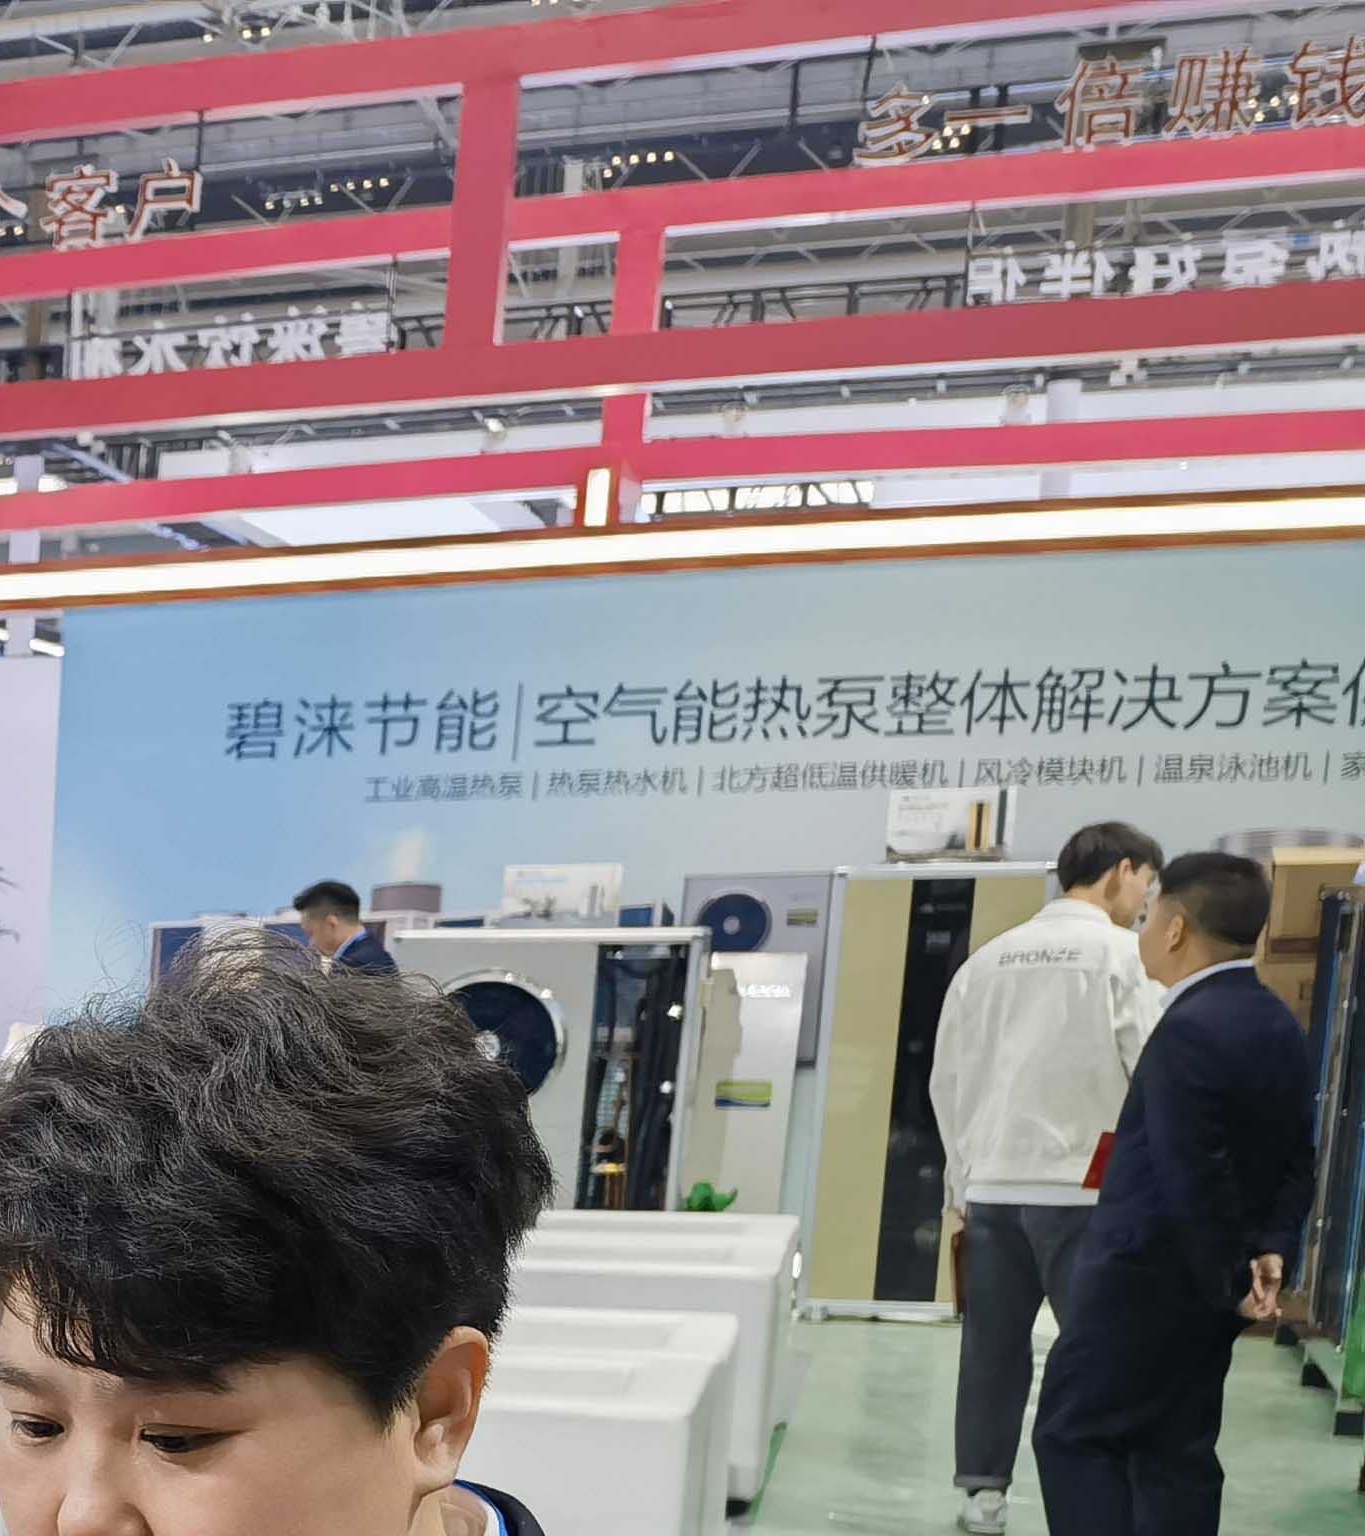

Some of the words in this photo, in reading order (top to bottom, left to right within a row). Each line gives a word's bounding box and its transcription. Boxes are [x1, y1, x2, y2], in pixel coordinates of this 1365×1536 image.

[853, 34, 1365, 168] 多一倍赚钱
[225, 688, 500, 760] 碧涞节能
[364, 772, 523, 803] 工业高温热泵
[547, 768, 688, 797] 热泵热水机
[711, 758, 948, 794] 北方超低温供暖机
[975, 752, 1127, 786] 风冷模块机
[1153, 749, 1311, 784] 温泉泳池机
